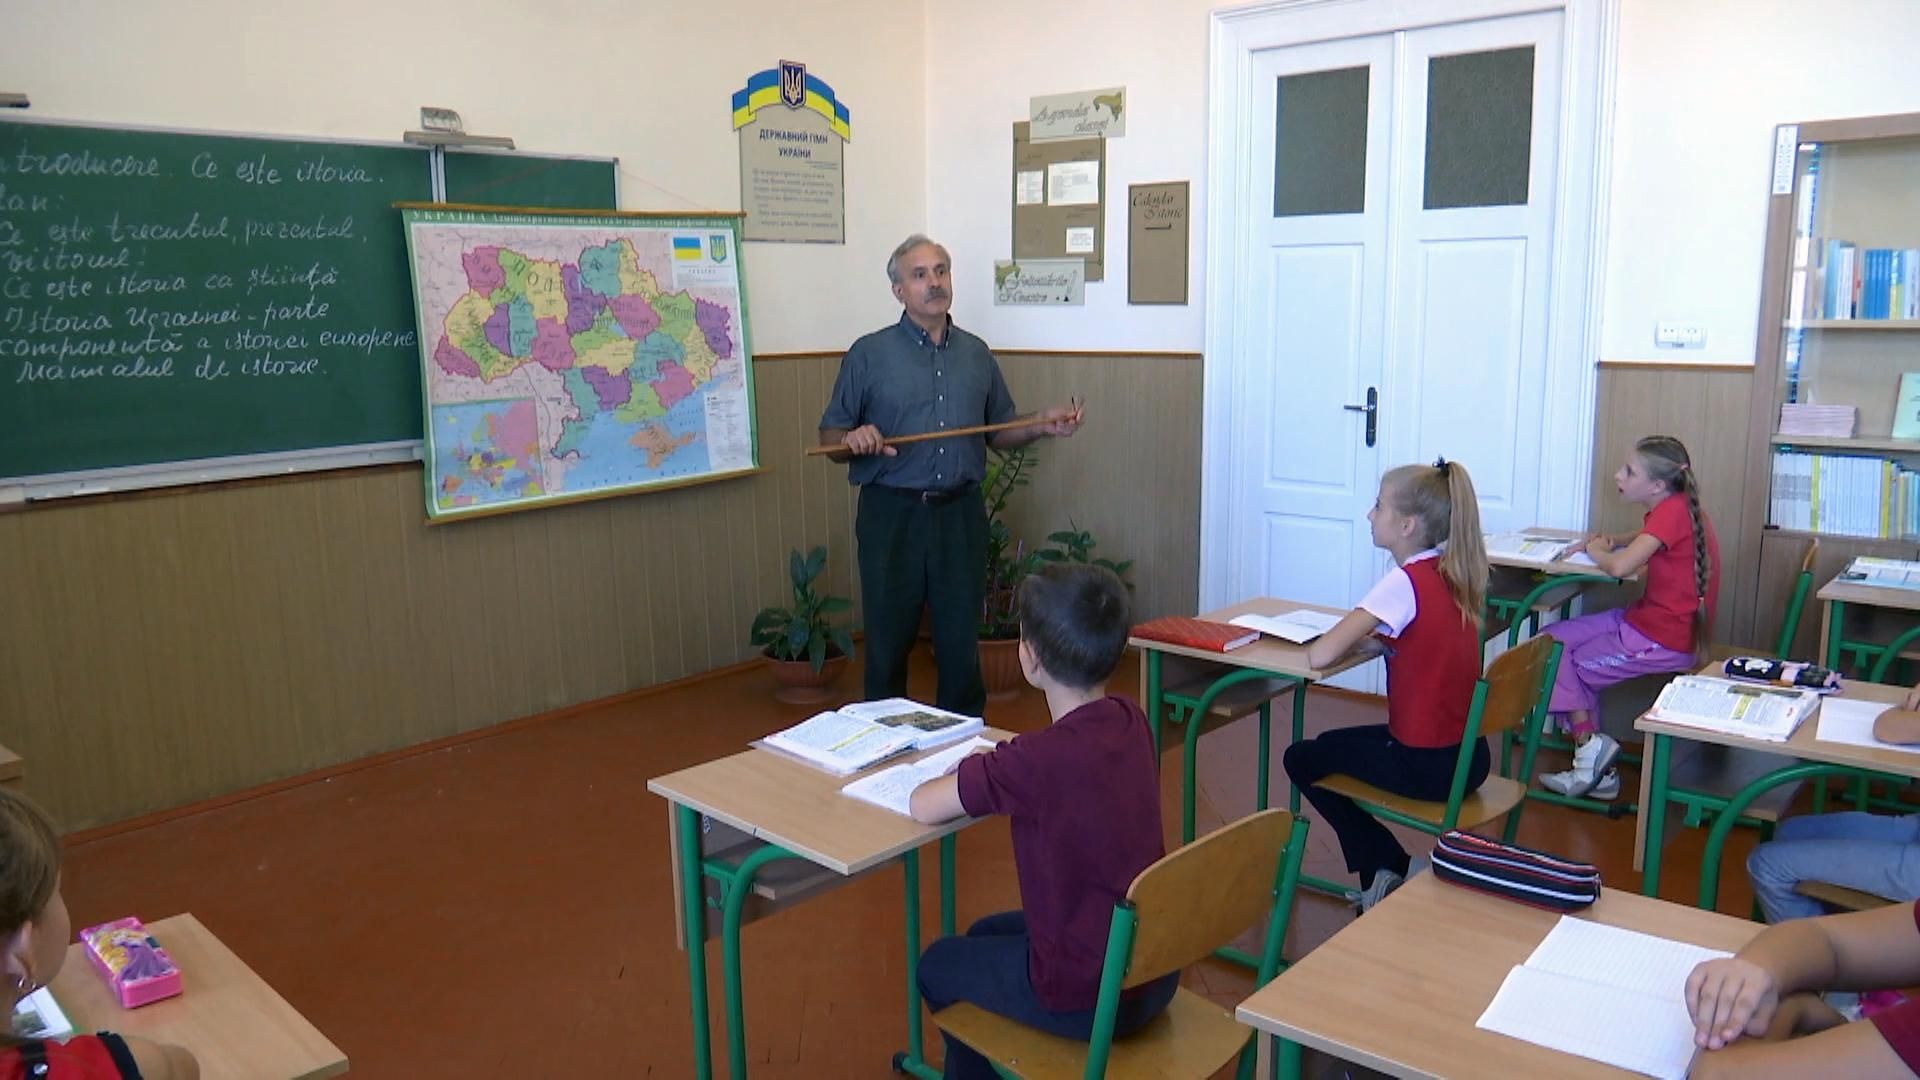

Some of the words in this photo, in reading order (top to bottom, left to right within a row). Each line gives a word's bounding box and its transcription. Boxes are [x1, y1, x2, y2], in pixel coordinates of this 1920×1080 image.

[759, 128, 808, 143] ДЕРЖАВНИЙ
[809, 134, 828, 144] ГІМН
[778, 147, 811, 158] УКРАЇНИ
[191, 153, 218, 178] Ce
[236, 153, 282, 184] este
[205, 273, 233, 290] ca
[263, 295, 330, 329] parte
[197, 337, 212, 349] a
